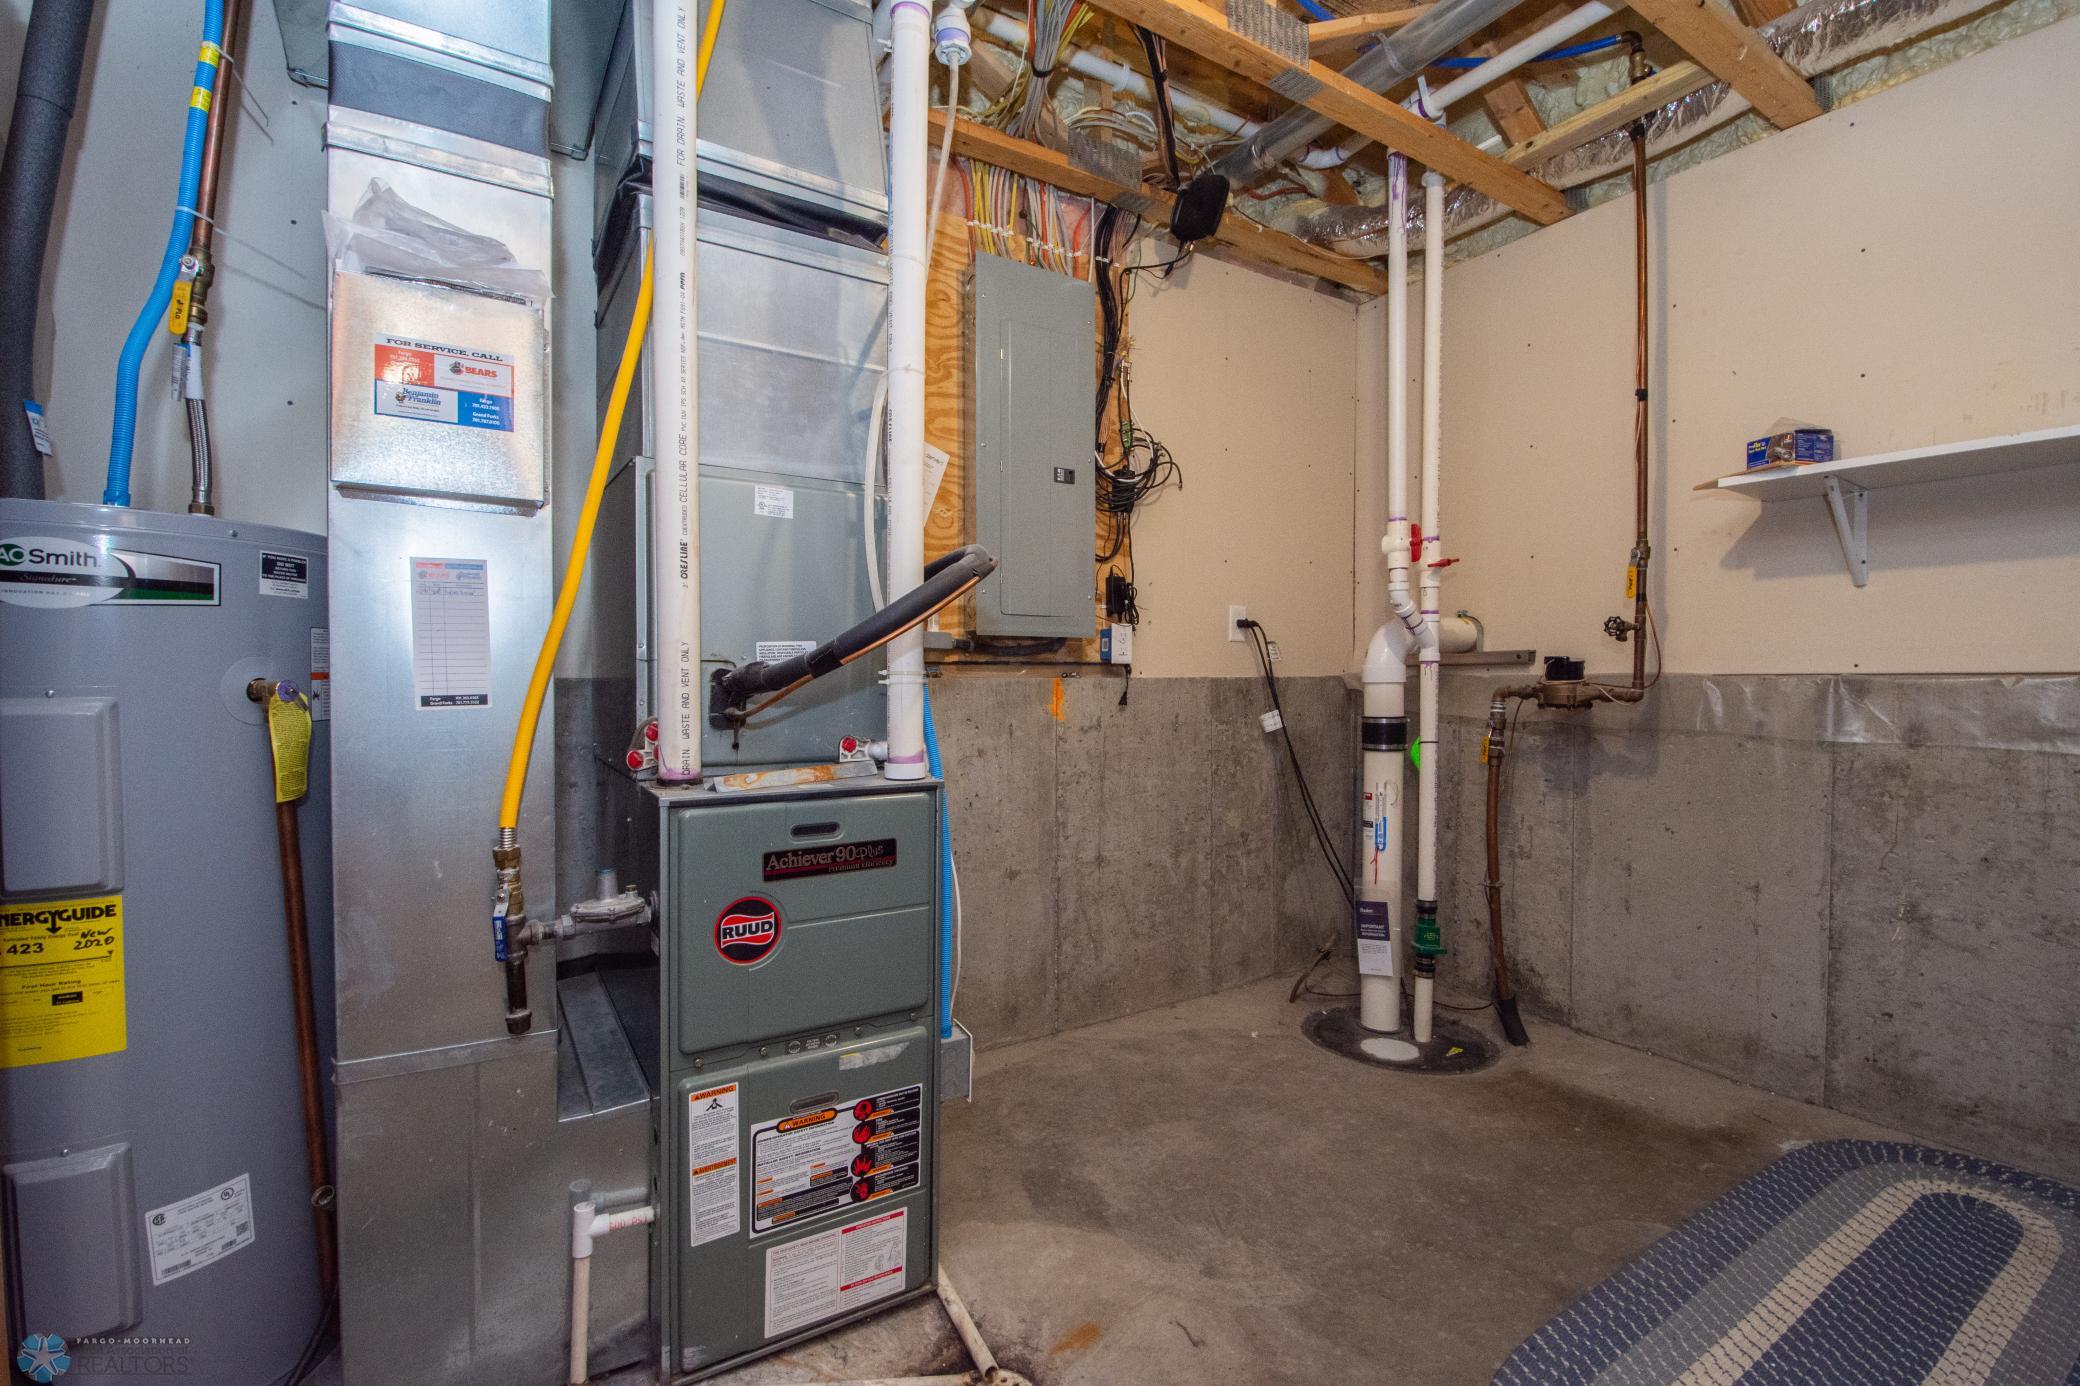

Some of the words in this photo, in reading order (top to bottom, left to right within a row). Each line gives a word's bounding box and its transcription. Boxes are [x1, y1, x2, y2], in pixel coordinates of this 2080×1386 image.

[677, 6, 687, 29] ONLY
[677, 32, 686, 54] VENT
[677, 58, 686, 77] AND
[677, 79, 687, 108] WASTE
[677, 149, 686, 166] FOR
[386, 338, 412, 347] FOR
[471, 351, 503, 362] CALL
[402, 387, 439, 399] Benjamin
[407, 395, 441, 405] Franklin
[679, 433, 687, 456] CORE
[679, 461, 688, 502] CELLULAR
[28, 549, 97, 567] Smith
[681, 641, 689, 663] ONLY
[681, 668, 690, 688] VENT
[682, 692, 690, 709] AND
[682, 713, 690, 740] WASTE
[765, 852, 834, 871] Achiever
[828, 863, 860, 873] Premium
[0, 904, 117, 930] NERGYGUIDE
[722, 920, 774, 940] RUUD
[6, 942, 44, 956] 423
[73, 936, 115, 950] 2020
[58, 979, 82, 987] Rating
[699, 1087, 734, 1098] WARNING
[792, 1114, 826, 1127] WARNING
